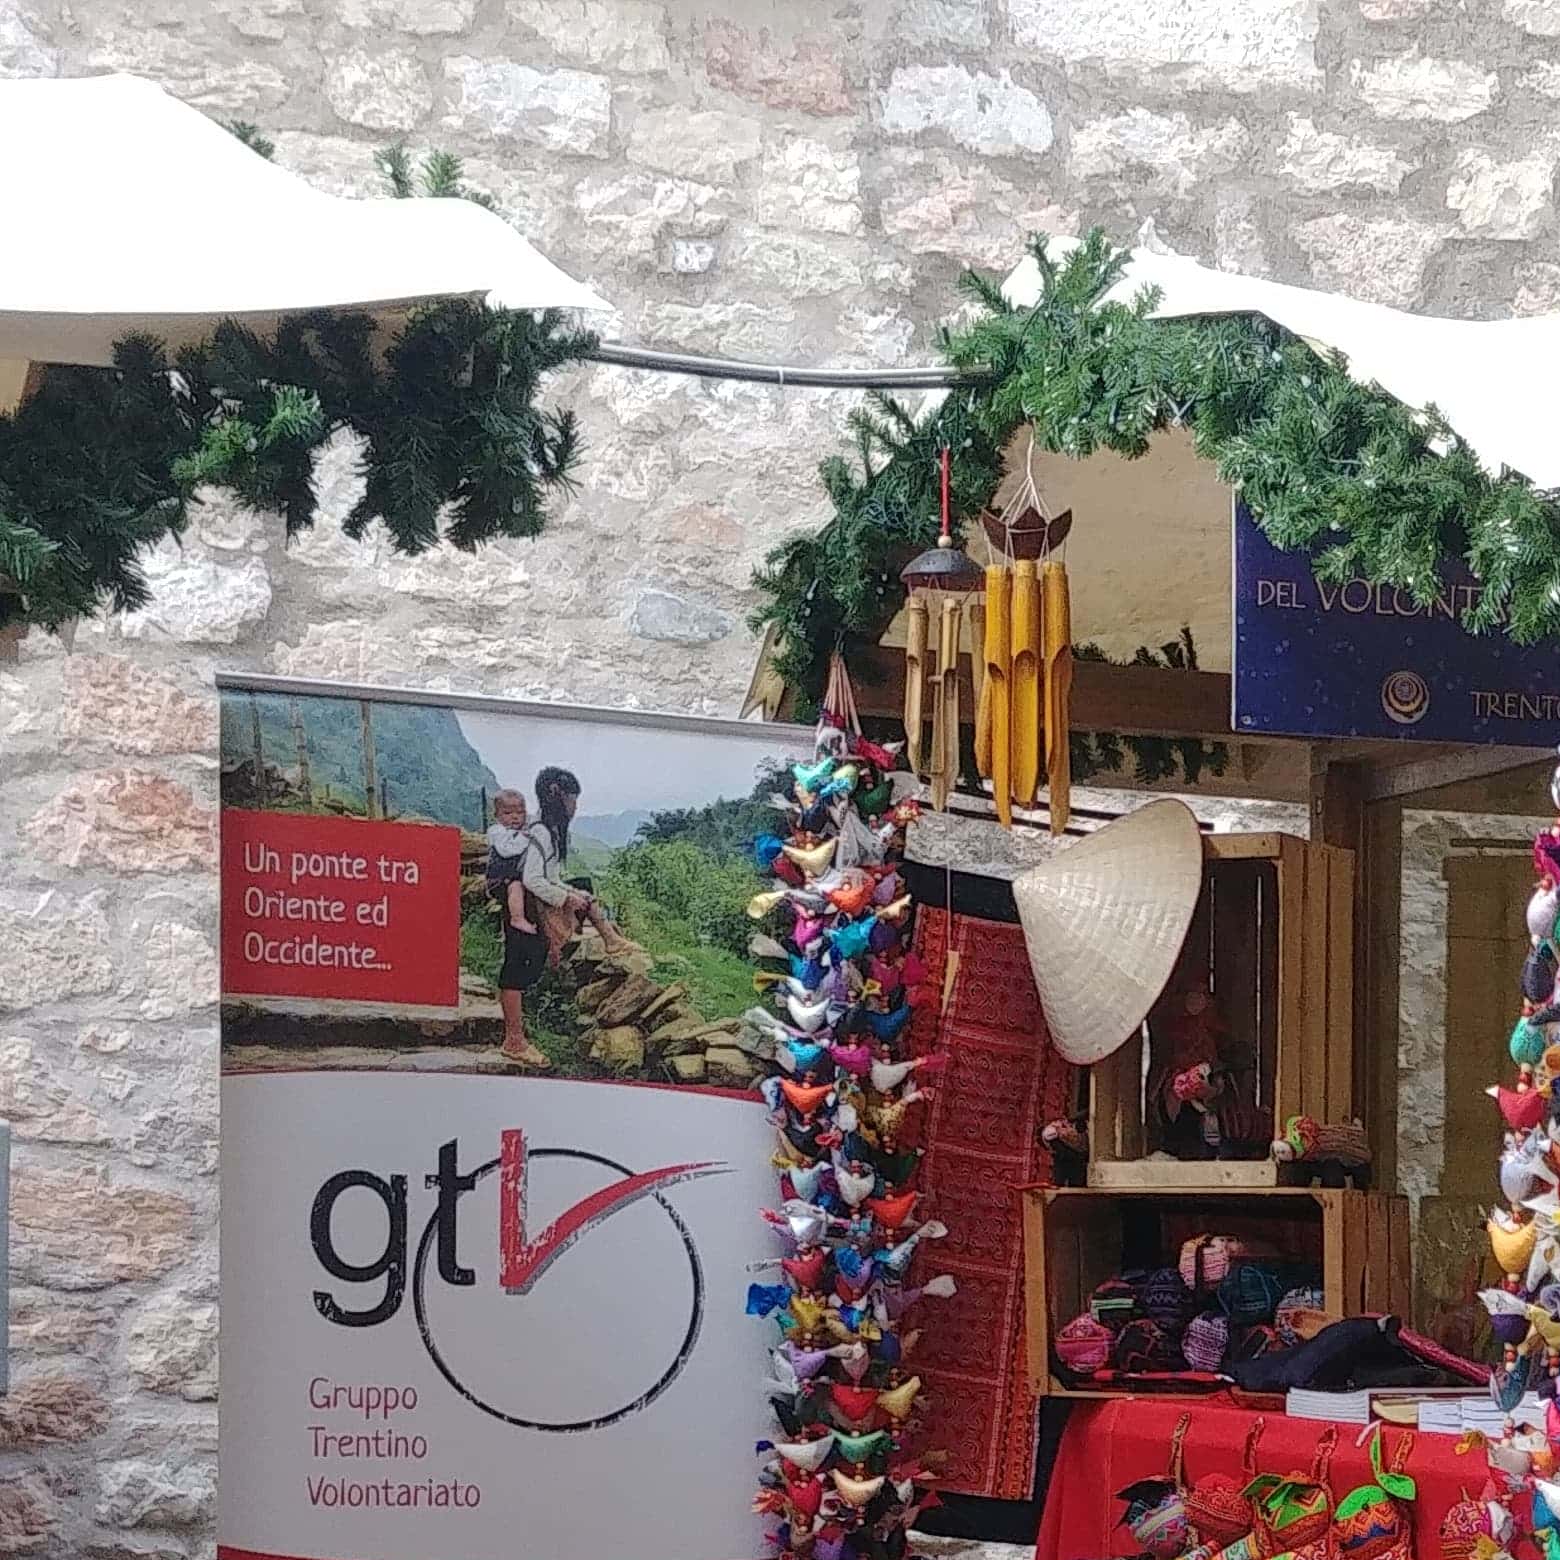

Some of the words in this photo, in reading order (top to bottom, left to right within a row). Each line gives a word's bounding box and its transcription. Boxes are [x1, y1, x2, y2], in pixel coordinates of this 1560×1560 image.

[1256, 580, 1306, 609] DEL
[1315, 577, 1508, 623] VOLONT
[244, 843, 283, 874] Un
[291, 849, 368, 882] ponte
[377, 857, 420, 885] tra
[244, 887, 346, 923] Oriente
[355, 895, 389, 928] ed
[308, 1378, 418, 1419] Gruppo
[308, 1428, 428, 1460] Trentino
[307, 1476, 481, 1509] Volontariato
